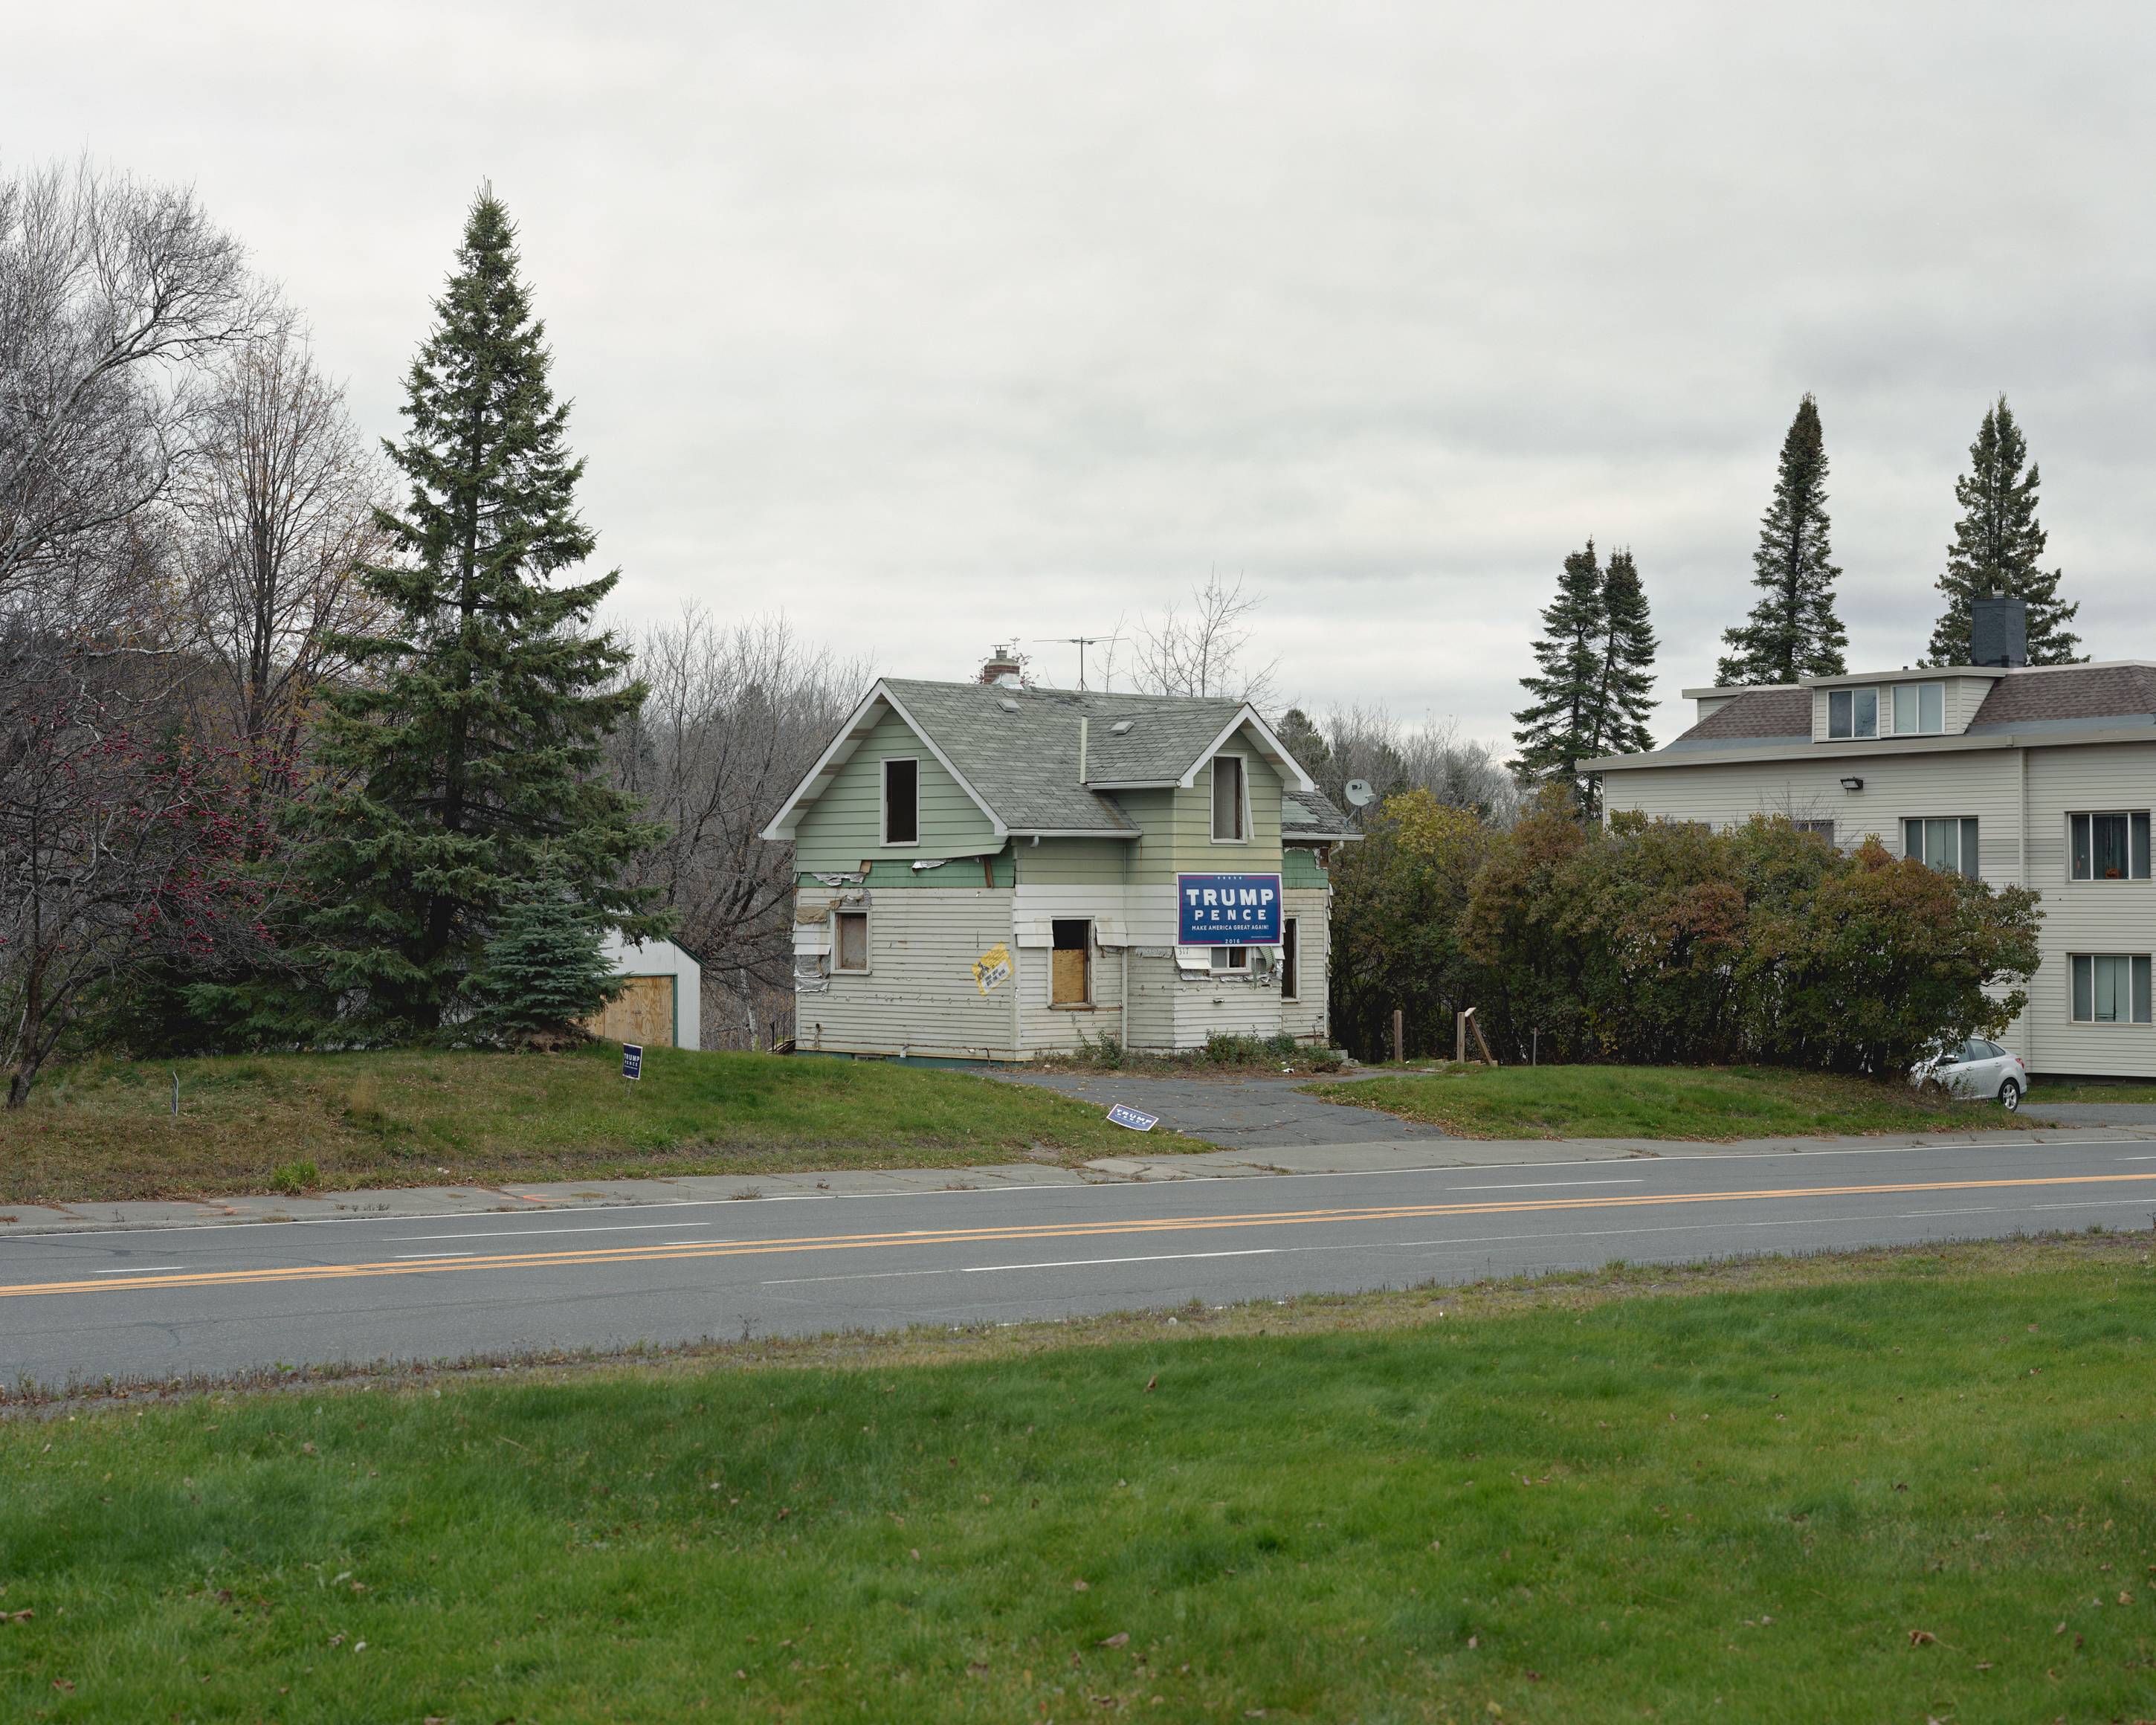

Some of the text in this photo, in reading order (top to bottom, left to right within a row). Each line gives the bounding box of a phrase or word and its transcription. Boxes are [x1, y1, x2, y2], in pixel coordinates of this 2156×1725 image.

[1186, 889, 1274, 906] TRUMP
[1195, 909, 1266, 920] PENCE
[624, 1053, 640, 1062] TRUMP
[1117, 1108, 1152, 1123] TRUMP
